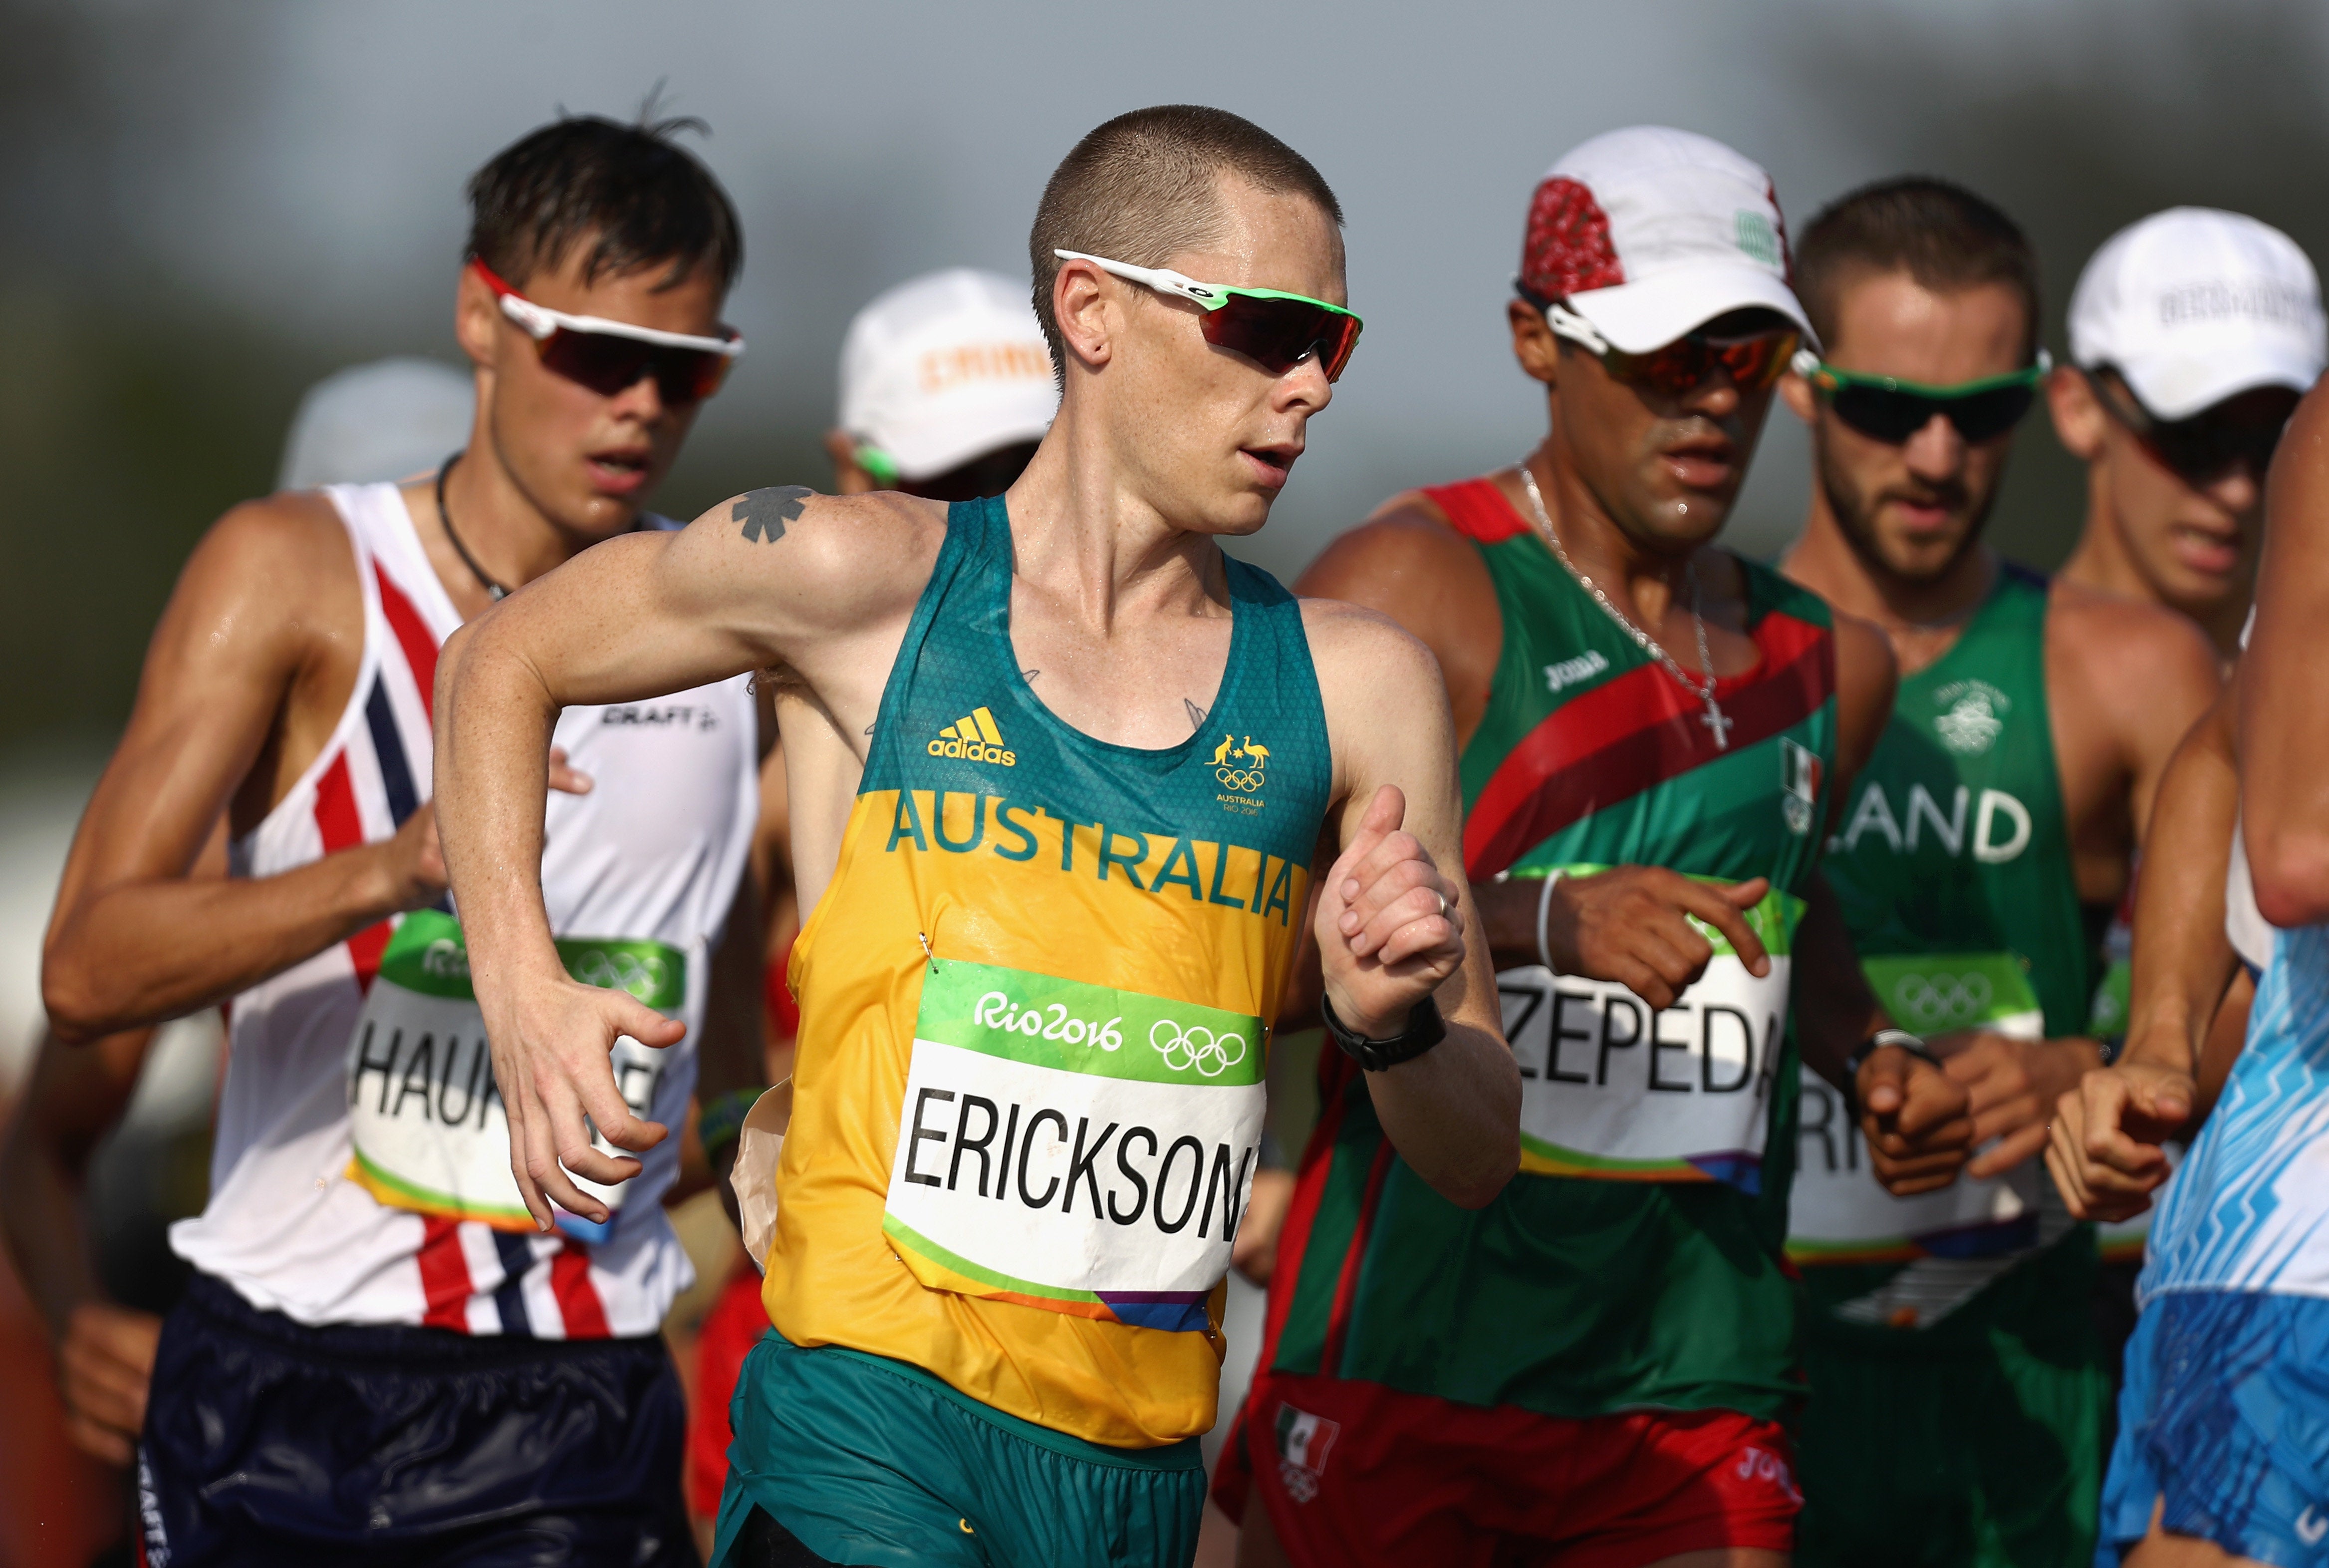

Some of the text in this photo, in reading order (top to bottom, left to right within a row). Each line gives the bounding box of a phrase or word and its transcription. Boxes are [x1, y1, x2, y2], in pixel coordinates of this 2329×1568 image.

[602, 705, 693, 725] CRAFT
[927, 737, 1016, 767] adidas
[1217, 794, 1265, 807] AUSTRALIA
[1224, 804, 1258, 816] RIO 2016
[886, 789, 1294, 926] AUSTRALIA
[904, 1087, 1252, 1242] ERICKSON
